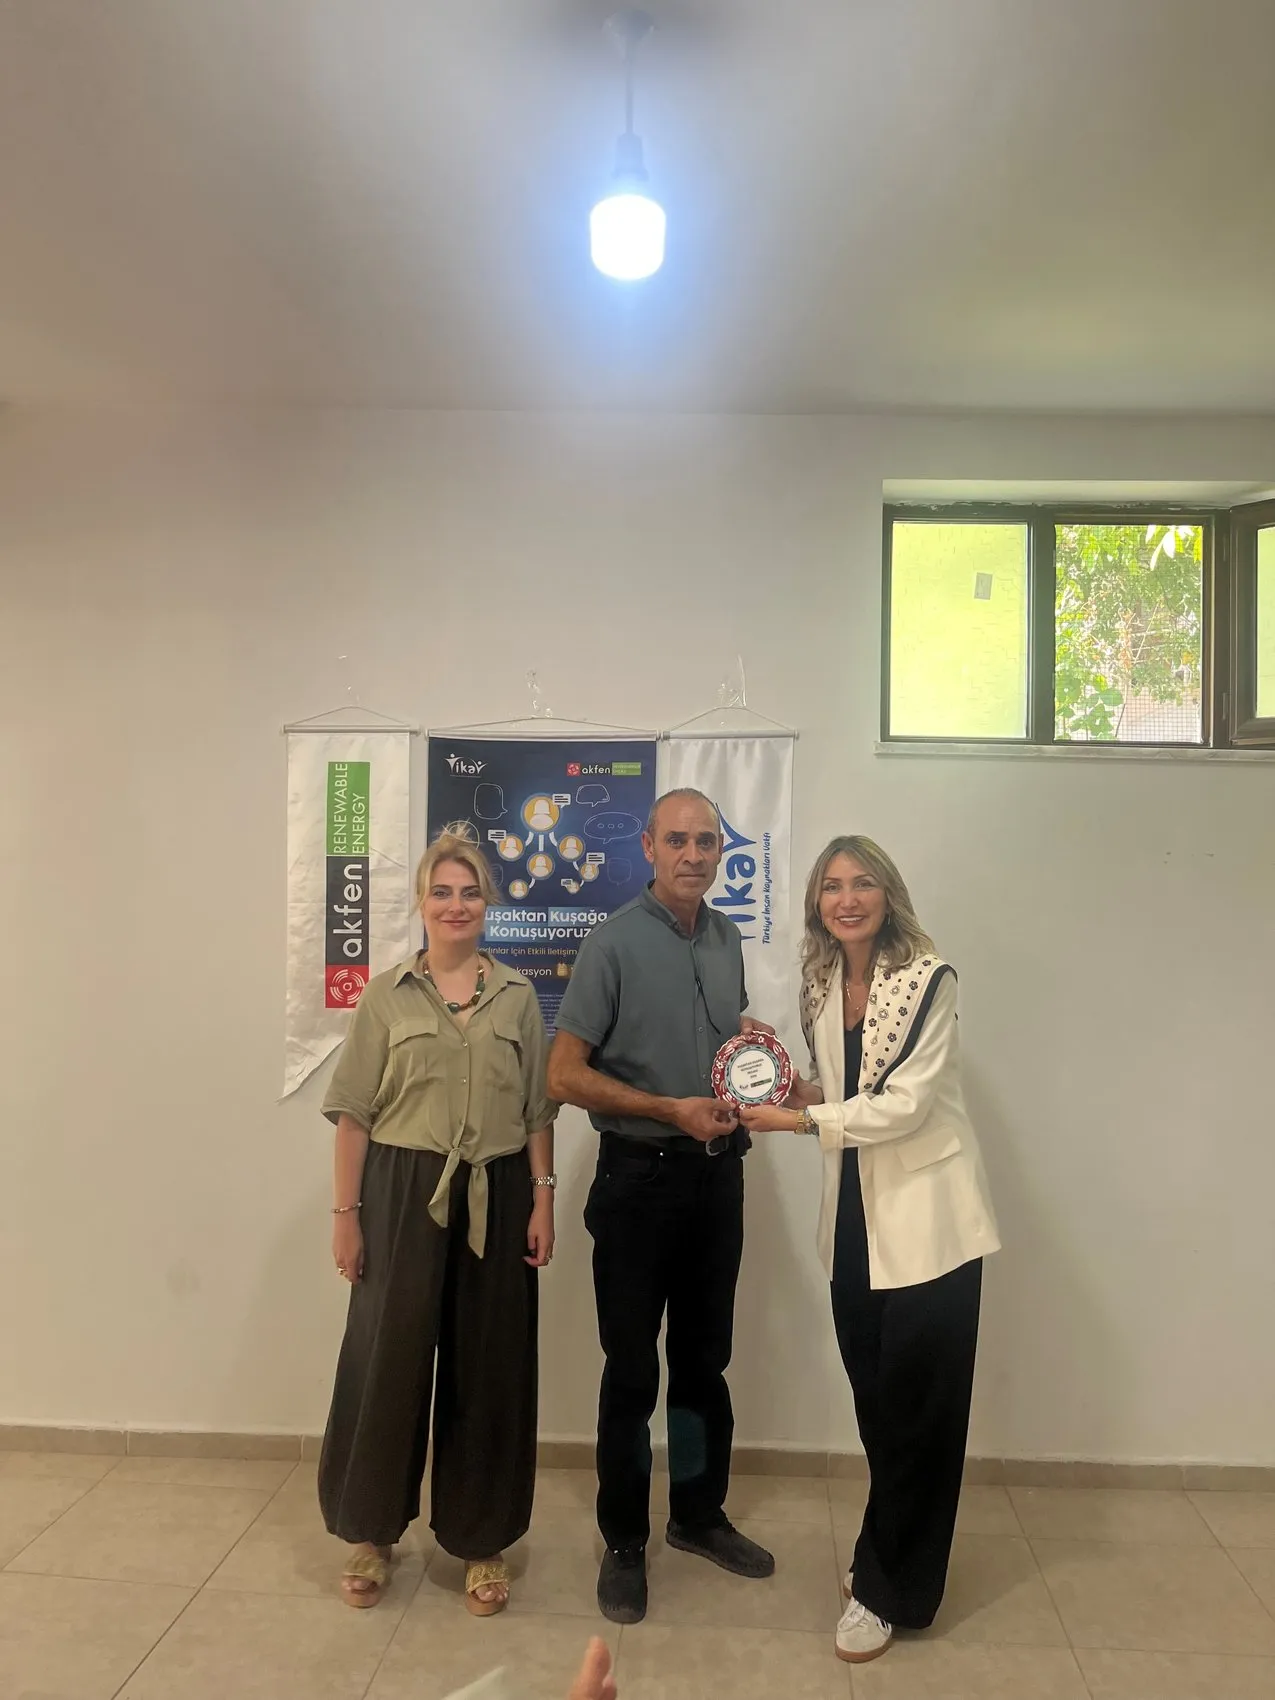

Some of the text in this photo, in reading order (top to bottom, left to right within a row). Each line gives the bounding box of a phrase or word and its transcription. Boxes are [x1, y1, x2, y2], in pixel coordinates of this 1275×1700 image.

[581, 764, 611, 774] akfen
[333, 763, 348, 854] RENEWABLE
[352, 792, 366, 854] ENERGY
[333, 863, 363, 958] akfen
[761, 894, 771, 915] İnsan
[485, 909, 608, 925] uşaktan Kuşağa
[490, 925, 592, 941] Konuşuyoruz
[762, 917, 772, 945] Türkiye
[527, 947, 546, 955] Etkili
